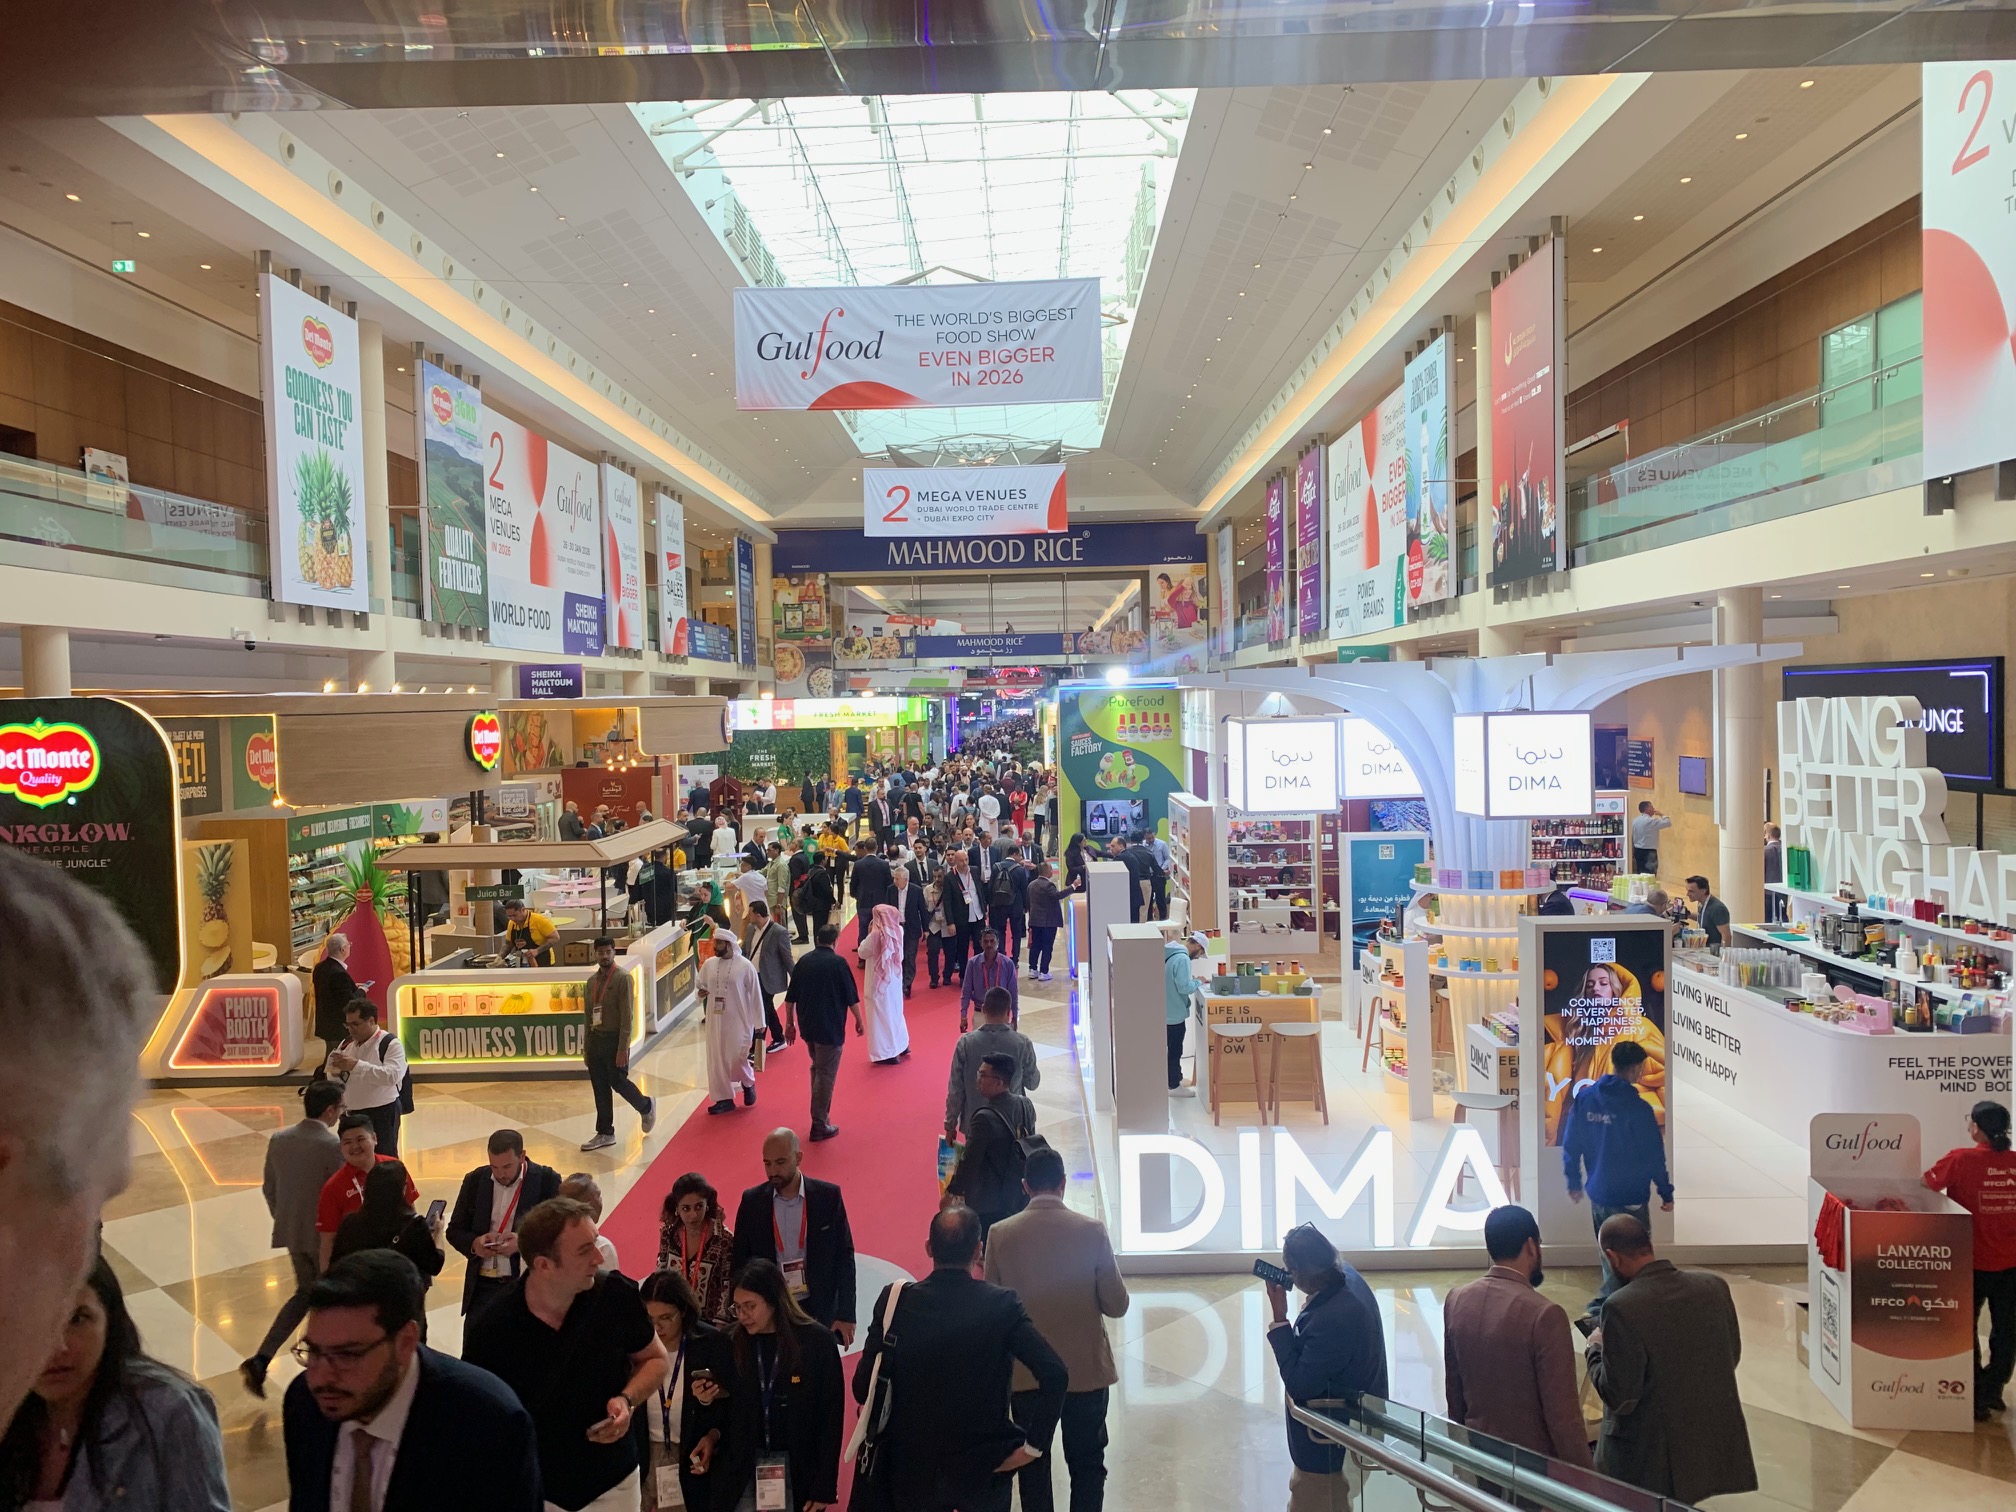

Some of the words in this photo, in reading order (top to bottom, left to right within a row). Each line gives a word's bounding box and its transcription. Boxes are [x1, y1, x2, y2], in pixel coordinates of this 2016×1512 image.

[1952, 69, 1993, 176] 2
[894, 314, 925, 327] THE
[930, 311, 1003, 326] WORLD'S
[1008, 308, 1077, 323] BIGGEST
[757, 307, 884, 380] Gulfood
[936, 331, 981, 345] FOOD
[986, 328, 1036, 343] SHOW
[919, 351, 972, 367] EVEN
[978, 346, 1055, 365] BIGGER
[951, 371, 970, 386] IN
[977, 369, 1024, 386] 2026
[286, 364, 333, 415] GOODNESS
[336, 387, 353, 423] YOU
[294, 402, 313, 440] CAN
[489, 431, 504, 490] 2
[1334, 440, 1362, 515] Gulfood
[557, 471, 592, 533] Gulfood
[917, 491, 961, 502] MEGA
[966, 488, 1027, 501] VENUES
[489, 495, 513, 518] MEGA
[882, 485, 910, 523] 2
[945, 505, 975, 513] WORLD
[1007, 503, 1039, 511] CENTRE
[490, 517, 521, 542] VENUES
[445, 524, 473, 561] QUALITY
[491, 541, 498, 552] IN
[498, 543, 512, 557] 2026
[887, 540, 1025, 565] MAHMOOD
[439, 557, 482, 595] FERTILIZERS
[626, 573, 637, 587] EVEN
[622, 586, 638, 600] BIGGER
[667, 579, 683, 598] SALES
[1357, 579, 1375, 600] POWER
[492, 600, 525, 626] WORLD
[528, 608, 551, 630] FOOD
[575, 602, 597, 619] SHEIKH
[1363, 597, 1384, 620] BRANDS
[567, 618, 598, 636] MAKTOUM
[586, 637, 598, 649] HALL
[956, 637, 1004, 647] MAHMOOD
[531, 670, 562, 678] SHEIKH
[531, 678, 573, 687] MAKTOUM
[532, 687, 553, 695] HALL
[1109, 696, 1164, 708] PureFood
[474, 729, 485, 744] Del
[484, 728, 500, 744] Monte
[1777, 697, 1926, 768] LIVING
[1071, 737, 1092, 748] SAUCES
[1071, 742, 1102, 757] FACTORY
[26, 747, 91, 769] Monte
[249, 749, 262, 765] Del
[1362, 762, 1403, 776] DIMA
[19, 771, 63, 787] Quality
[1265, 775, 1311, 789] DIMA
[1509, 775, 1562, 791] DIMA
[1780, 764, 1950, 846] BETTER
[477, 888, 497, 898] Juice
[499, 888, 513, 897] Bar
[1569, 997, 1642, 1008] CONFIDENCE
[1673, 979, 1702, 1003] LIVING
[1704, 993, 1732, 1017] WELL
[225, 997, 267, 1018] PHOTO
[1208, 1006, 1233, 1015] LIFE
[1239, 1006, 1250, 1015] IS
[1561, 1008, 1572, 1017] IN
[1576, 1007, 1612, 1017] EVERY
[226, 1018, 268, 1039] BOOTH
[1580, 1016, 1642, 1026] HAPPINESS
[1593, 1026, 1605, 1036] IN
[1608, 1025, 1645, 1036] EVERY
[1673, 1009, 1702, 1036] LIVING
[1704, 1028, 1742, 1056] BETTER
[419, 1026, 516, 1059] GOODNESS
[523, 1024, 557, 1056] YOU
[1209, 1045, 1245, 1054] FOW
[1470, 1044, 1490, 1074] DIMA
[1673, 1040, 1702, 1067] LIVING
[1705, 1059, 1737, 1086] HAPPY
[1888, 1057, 1923, 1068] FEEL
[1928, 1056, 1956, 1067] THE
[1905, 1069, 1985, 1081] HAPPINESS
[1940, 1081, 1977, 1093] MIND
[1825, 1121, 1903, 1161] Gulfood
[1119, 1124, 1512, 1252] DIMA
[1877, 1244, 1952, 1260] LANYARD
[1877, 1258, 1952, 1271] COLLECTION
[1871, 1298, 1906, 1307] IFFCO
[1871, 1374, 1925, 1399] Gulfood
